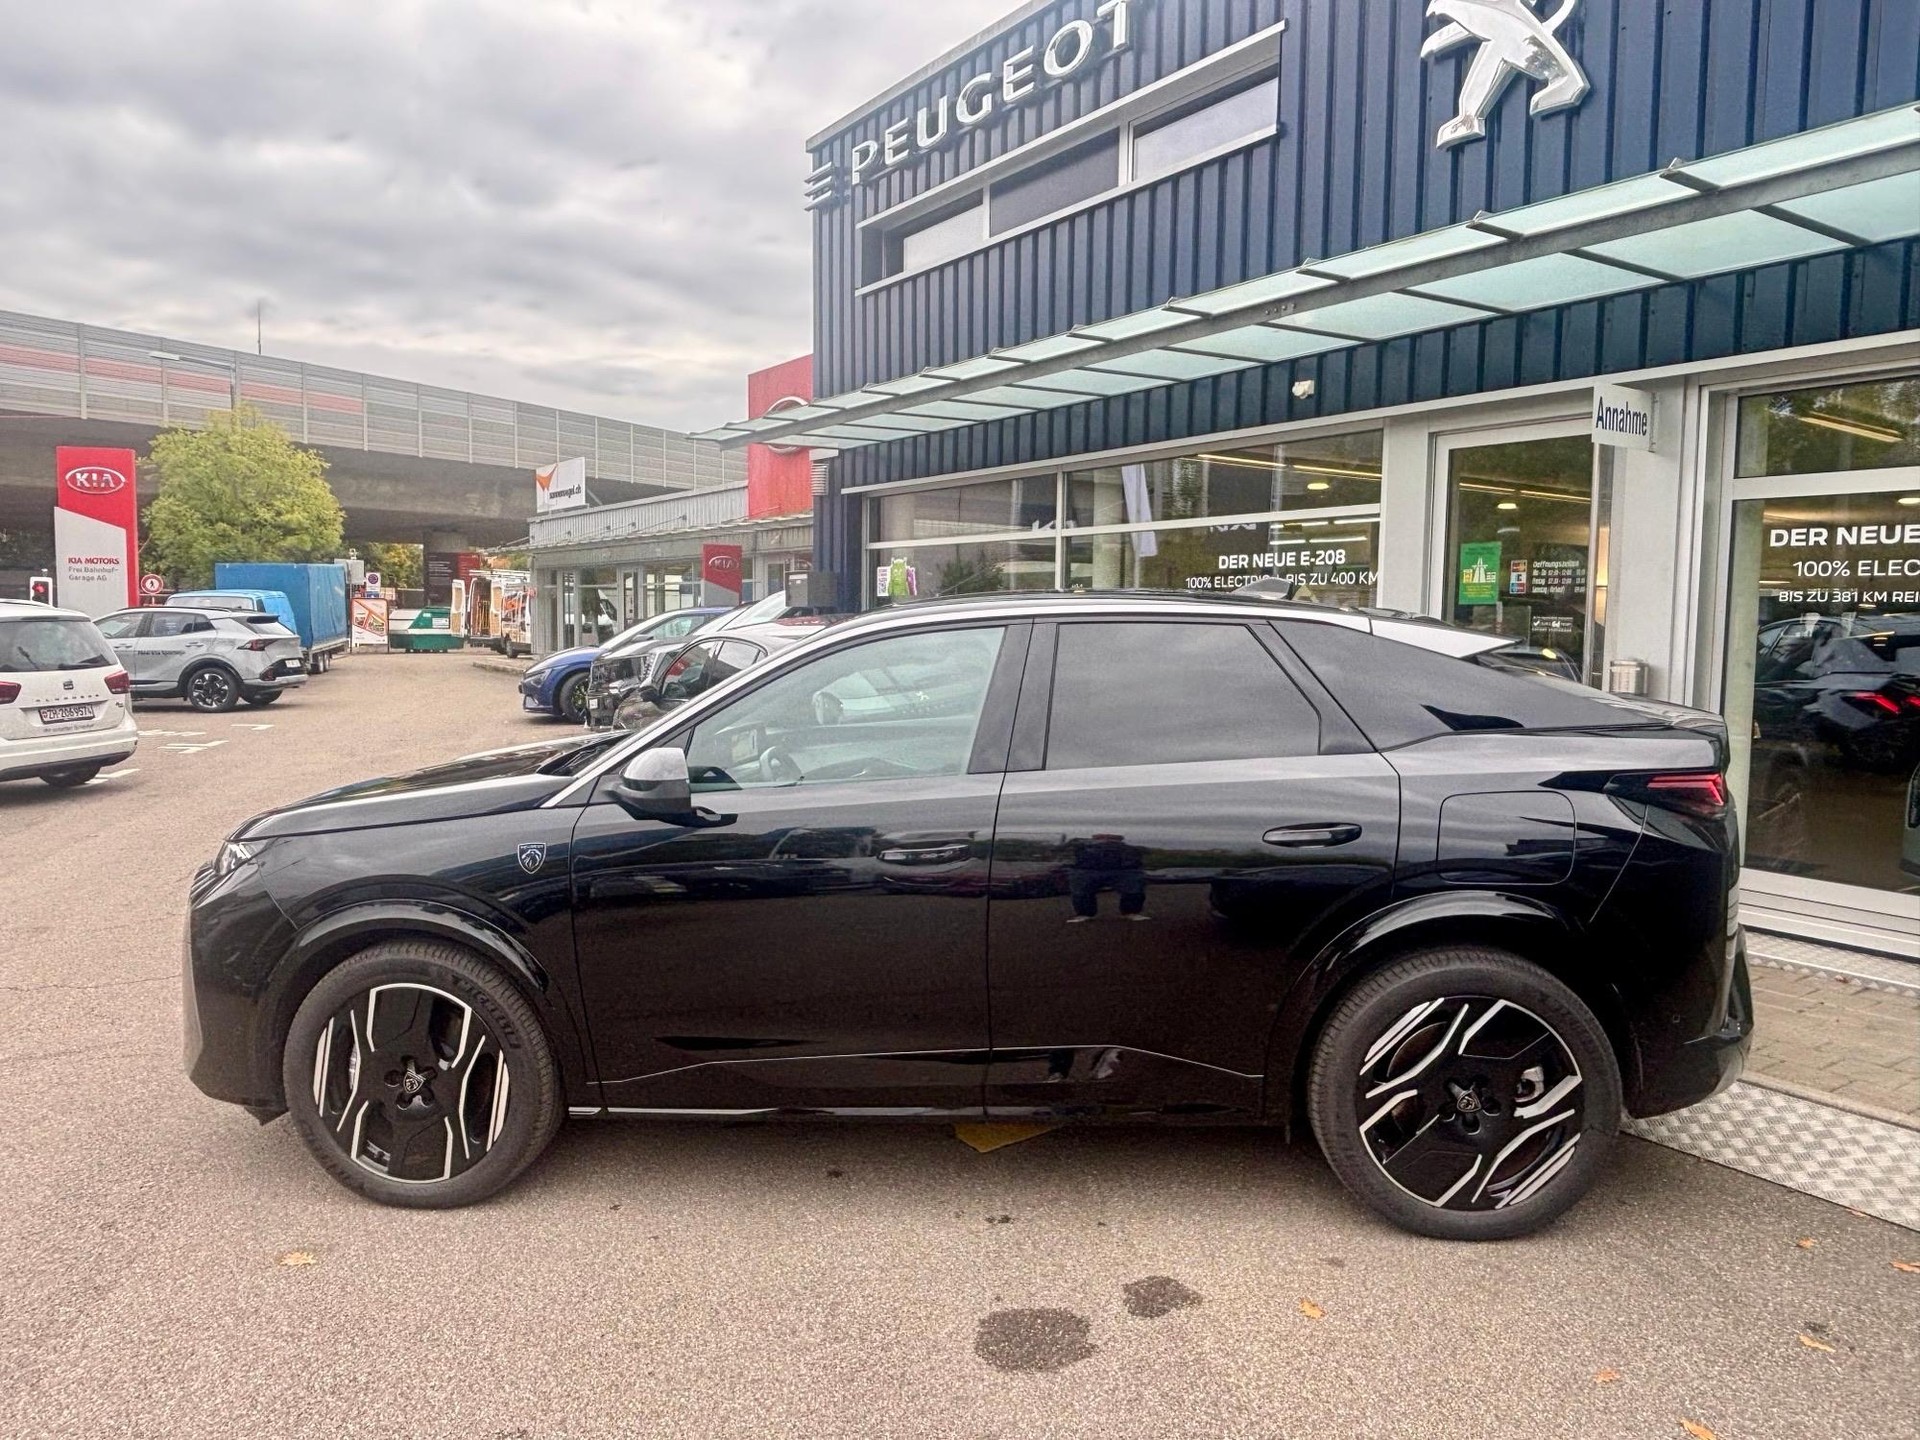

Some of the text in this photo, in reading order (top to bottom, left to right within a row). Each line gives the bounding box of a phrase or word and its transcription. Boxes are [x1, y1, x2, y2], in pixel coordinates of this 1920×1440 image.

[851, 0, 1127, 185] PEUGEOT
[1596, 396, 1648, 436] Annahme
[76, 472, 115, 488] KIA
[1769, 525, 1920, 547] DER NEUE
[68, 557, 120, 565] KIA MOTORS
[1218, 549, 1346, 569] DER NEUE E-208
[1792, 559, 1920, 577] 100% ELEC
[1185, 576, 1212, 589] 100%
[1309, 572, 1328, 586] ZU
[1330, 571, 1356, 585] 400
[1359, 570, 1379, 586] KM
[1779, 590, 1803, 602] BIS
[1806, 591, 1829, 602] ZU
[1832, 591, 1858, 602] 381
[1863, 591, 1887, 602] KM
